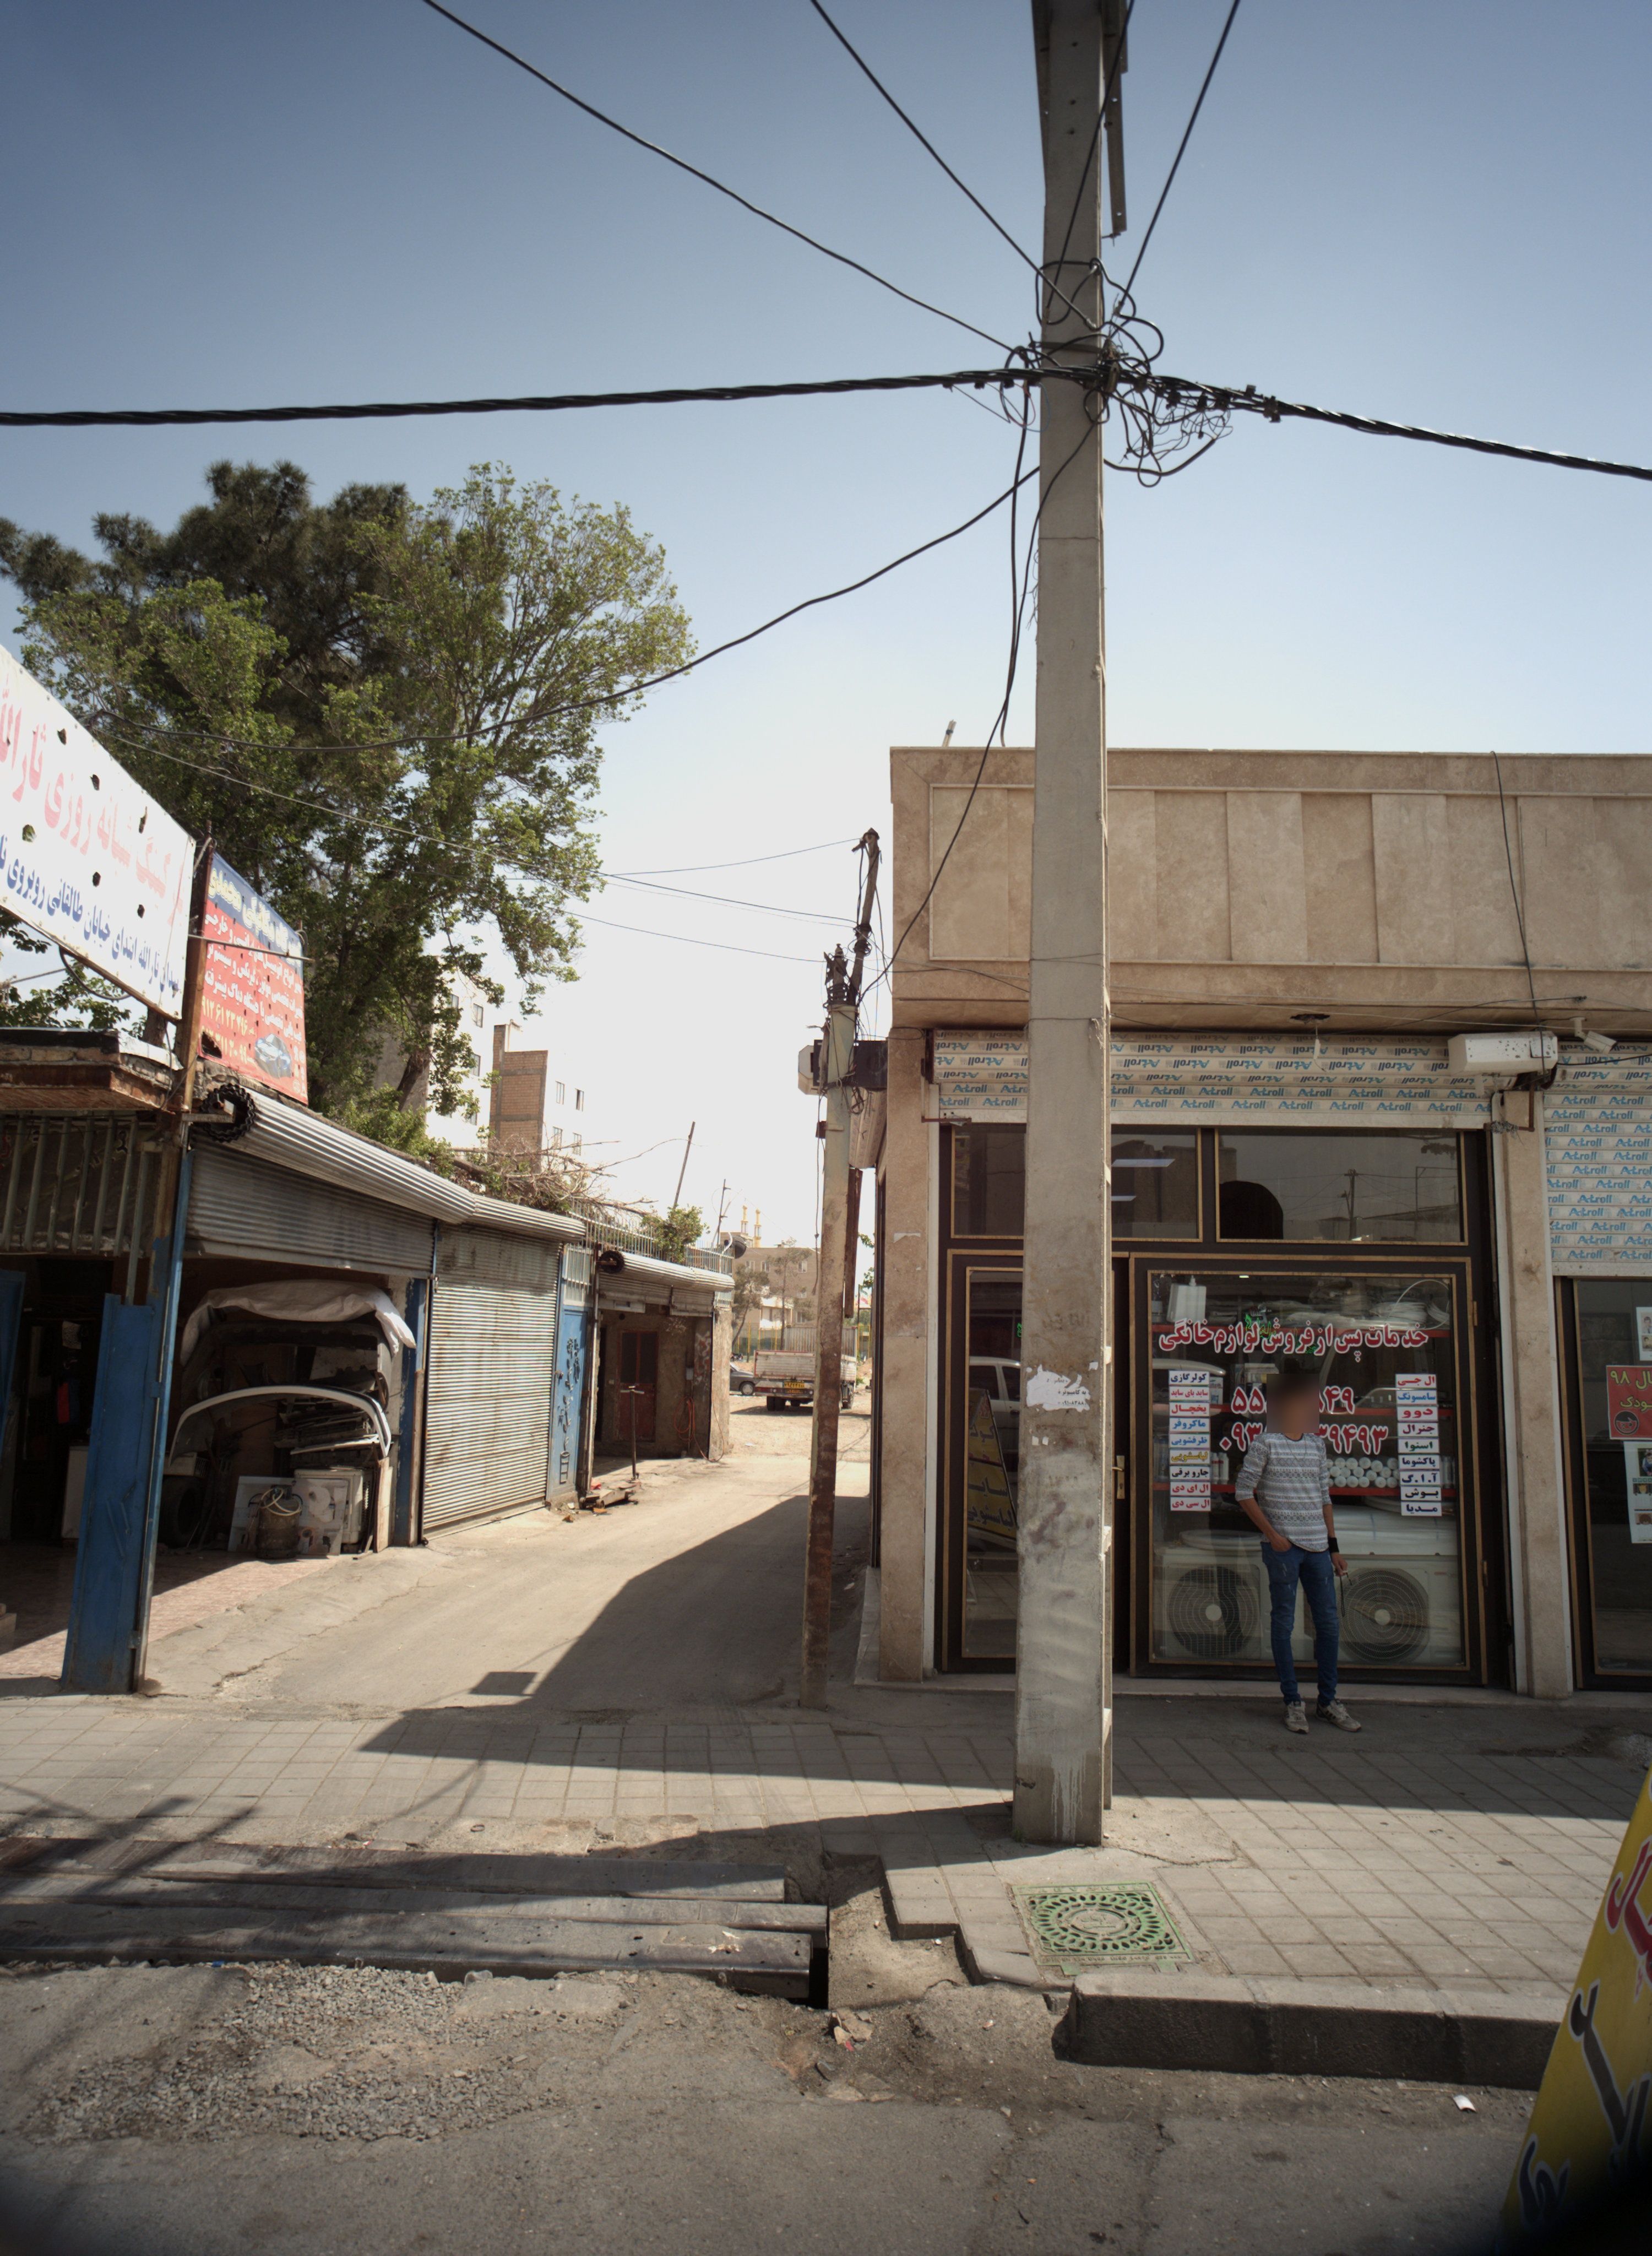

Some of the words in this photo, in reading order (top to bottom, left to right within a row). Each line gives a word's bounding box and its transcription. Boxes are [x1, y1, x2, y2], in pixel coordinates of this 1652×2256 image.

[45, 772, 92, 855] روزی
[97, 794, 132, 875] شبانه
[7, 858, 45, 909] روبروی
[47, 877, 83, 916] طالقانی
[84, 904, 110, 947] خیابان
[112, 926, 137, 968] ابتدای
[986, 1043, 1023, 1051] Atroll
[1138, 1044, 1173, 1053] Atroll
[1191, 1045, 1226, 1053] Atroll
[1240, 1045, 1275, 1054] Atroll
[1342, 1047, 1377, 1055] Atroll
[1394, 1048, 1430, 1056] Atroll
[968, 1057, 1004, 1066] Atroll
[1123, 1059, 1160, 1067] Atroll
[1172, 1059, 1210, 1068] Atroll
[1226, 1060, 1263, 1069] Atroll
[1275, 1061, 1312, 1070] Atroll
[1329, 1061, 1365, 1070] Atroll
[1378, 1062, 1415, 1071] Atroll
[1573, 1071, 1610, 1080] Atroll
[953, 1084, 987, 1093] Atroll
[1111, 1086, 1134, 1094] troll
[1151, 1086, 1185, 1095] Atroll
[1199, 1087, 1232, 1096] Atroll
[1250, 1087, 1284, 1096] Atroll
[1297, 1088, 1332, 1097] Atroll
[1349, 1089, 1383, 1097] Atroll
[1396, 1089, 1430, 1098] Atroll
[982, 1098, 1018, 1107] Atroll
[1133, 1099, 1167, 1108] Atroll
[1180, 1099, 1215, 1108] Atroll
[1231, 1100, 1266, 1109] Atroll
[1279, 1100, 1313, 1109] Atroll
[1329, 1102, 1364, 1110] Atroll
[1377, 1102, 1411, 1110] Atroll
[1428, 1103, 1462, 1111] Atroll
[1562, 1096, 1596, 1104] Atroll
[1609, 1097, 1644, 1105] Atroll
[1551, 1110, 1586, 1119] Atroll
[1599, 1110, 1633, 1119] Atroll
[1583, 1124, 1617, 1133] Atroll
[1568, 1138, 1602, 1146] Atroll
[1616, 1138, 1650, 1147] Atroll
[1562, 1151, 1597, 1160] Atroll
[1613, 1152, 1648, 1160] Atroll
[1572, 1165, 1607, 1174] Atroll
[1596, 1180, 1631, 1189] Atroll
[1577, 1194, 1612, 1203] Atroll
[1569, 1207, 1604, 1216] Atroll
[1617, 1208, 1651, 1217] Atroll
[1591, 1222, 1626, 1230] Atroll
[1577, 1235, 1612, 1244] Atroll
[1568, 1250, 1602, 1259] Atroll
[1158, 1317, 1214, 1352] خانگی
[1213, 1320, 1260, 1354] لوازم
[1261, 1316, 1315, 1355] فروش
[1313, 1323, 1334, 1357] از
[1334, 1328, 1363, 1363] پس
[1170, 1374, 1190, 1383] گازی
[1191, 1373, 1207, 1383] کولر
[1397, 1378, 1421, 1386] جی
[1425, 1376, 1435, 1386] ال
[1610, 1370, 1631, 1384] ۹۸
[1635, 1370, 1652, 1390] ال
[1171, 1389, 1183, 1398] ساید
[1184, 1389, 1194, 1398] بای
[1196, 1389, 1209, 1398] ساید
[1397, 1391, 1436, 1402] سامسونگ
[1620, 1396, 1652, 1412] ودک
[1171, 1404, 1207, 1415] یخچال
[1401, 1407, 1433, 1418] دوو
[1172, 1419, 1206, 1430] ماکروفر
[1402, 1424, 1435, 1435] جنرال
[1171, 1436, 1208, 1446] ظرفشویی
[1404, 1440, 1433, 1452] اسنوا
[1171, 1451, 1208, 1463] لباسشویی
[1401, 1457, 1436, 1468] پاکشوما
[1171, 1468, 1190, 1478] برقی
[1191, 1468, 1209, 1477] جارو
[1172, 1484, 1184, 1493] دی
[1187, 1483, 1197, 1493] ای
[1199, 1483, 1209, 1493] ال
[1405, 1488, 1439, 1498] بوش
[1171, 1499, 1184, 1509] دی
[1201, 1499, 1210, 1509] ال
[1406, 1504, 1438, 1514] مدیا
